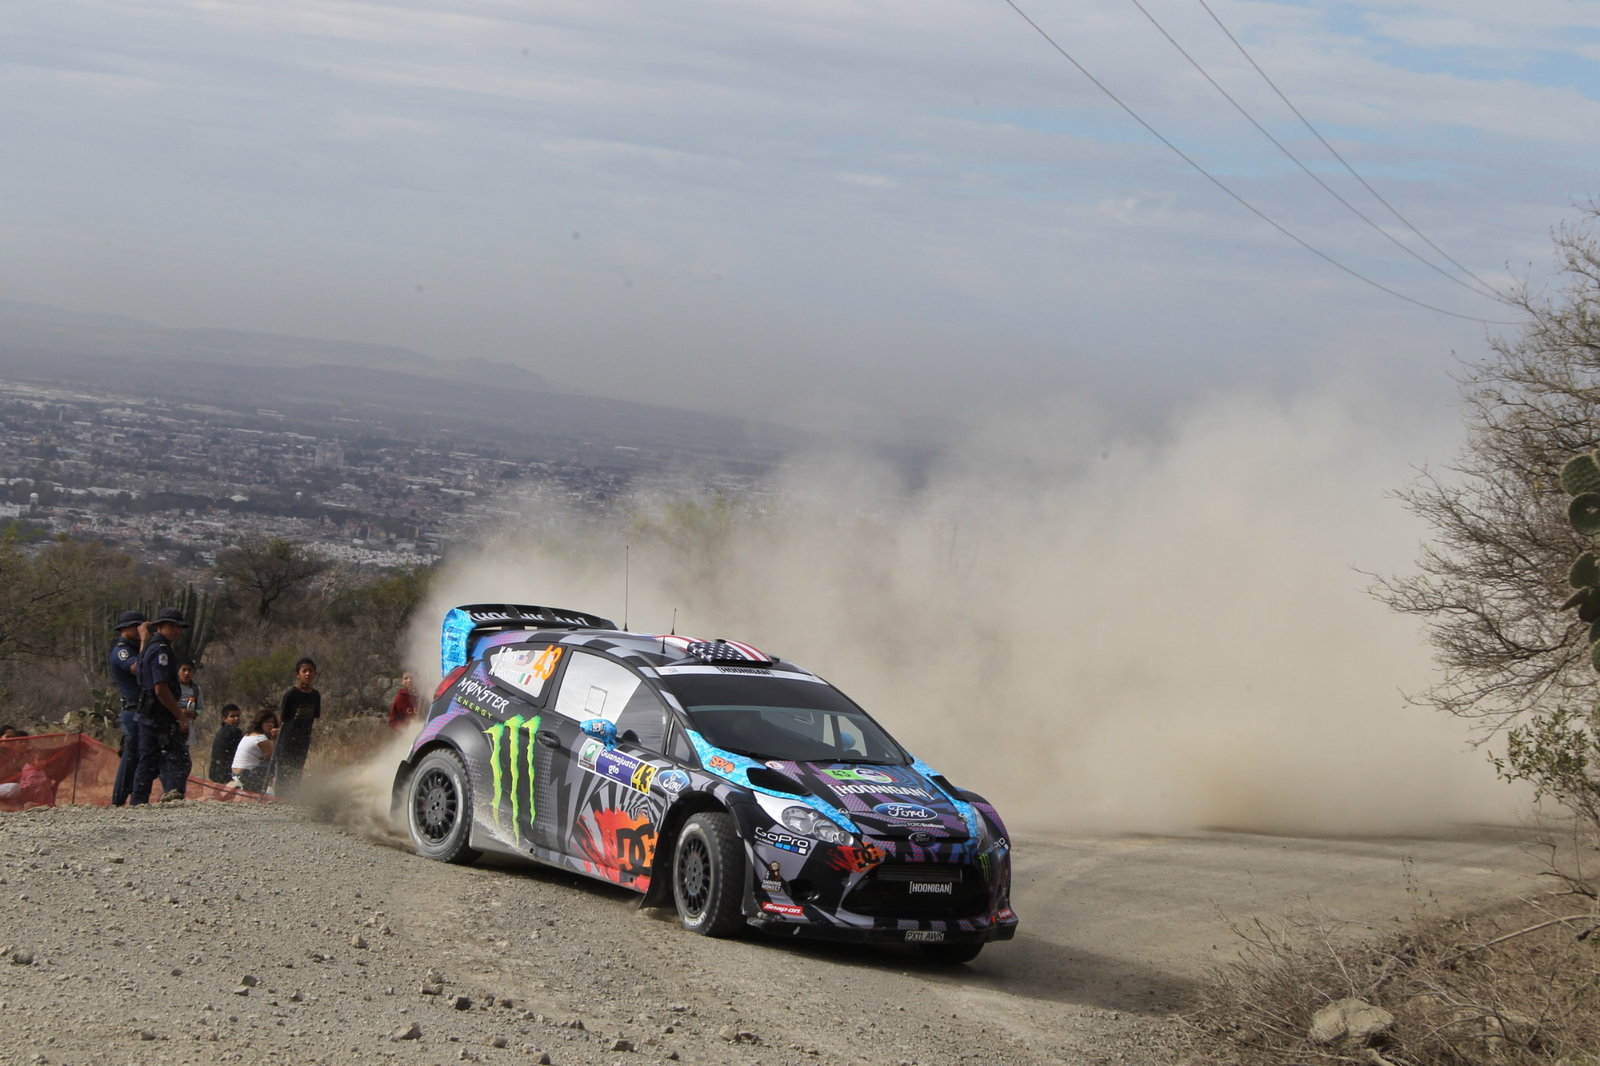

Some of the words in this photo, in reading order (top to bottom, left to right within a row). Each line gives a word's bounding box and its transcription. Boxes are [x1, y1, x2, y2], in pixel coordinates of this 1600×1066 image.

[533, 645, 562, 680] 43
[457, 696, 493, 719] ENERGY
[600, 750, 637, 770] Guanajuato
[632, 763, 655, 795] 43
[663, 772, 685, 792] Ford
[832, 769, 851, 778] 43
[887, 805, 928, 818] Ford
[755, 826, 810, 848] GoPro
[616, 822, 655, 876] DC
[764, 903, 801, 913] Snap-on
